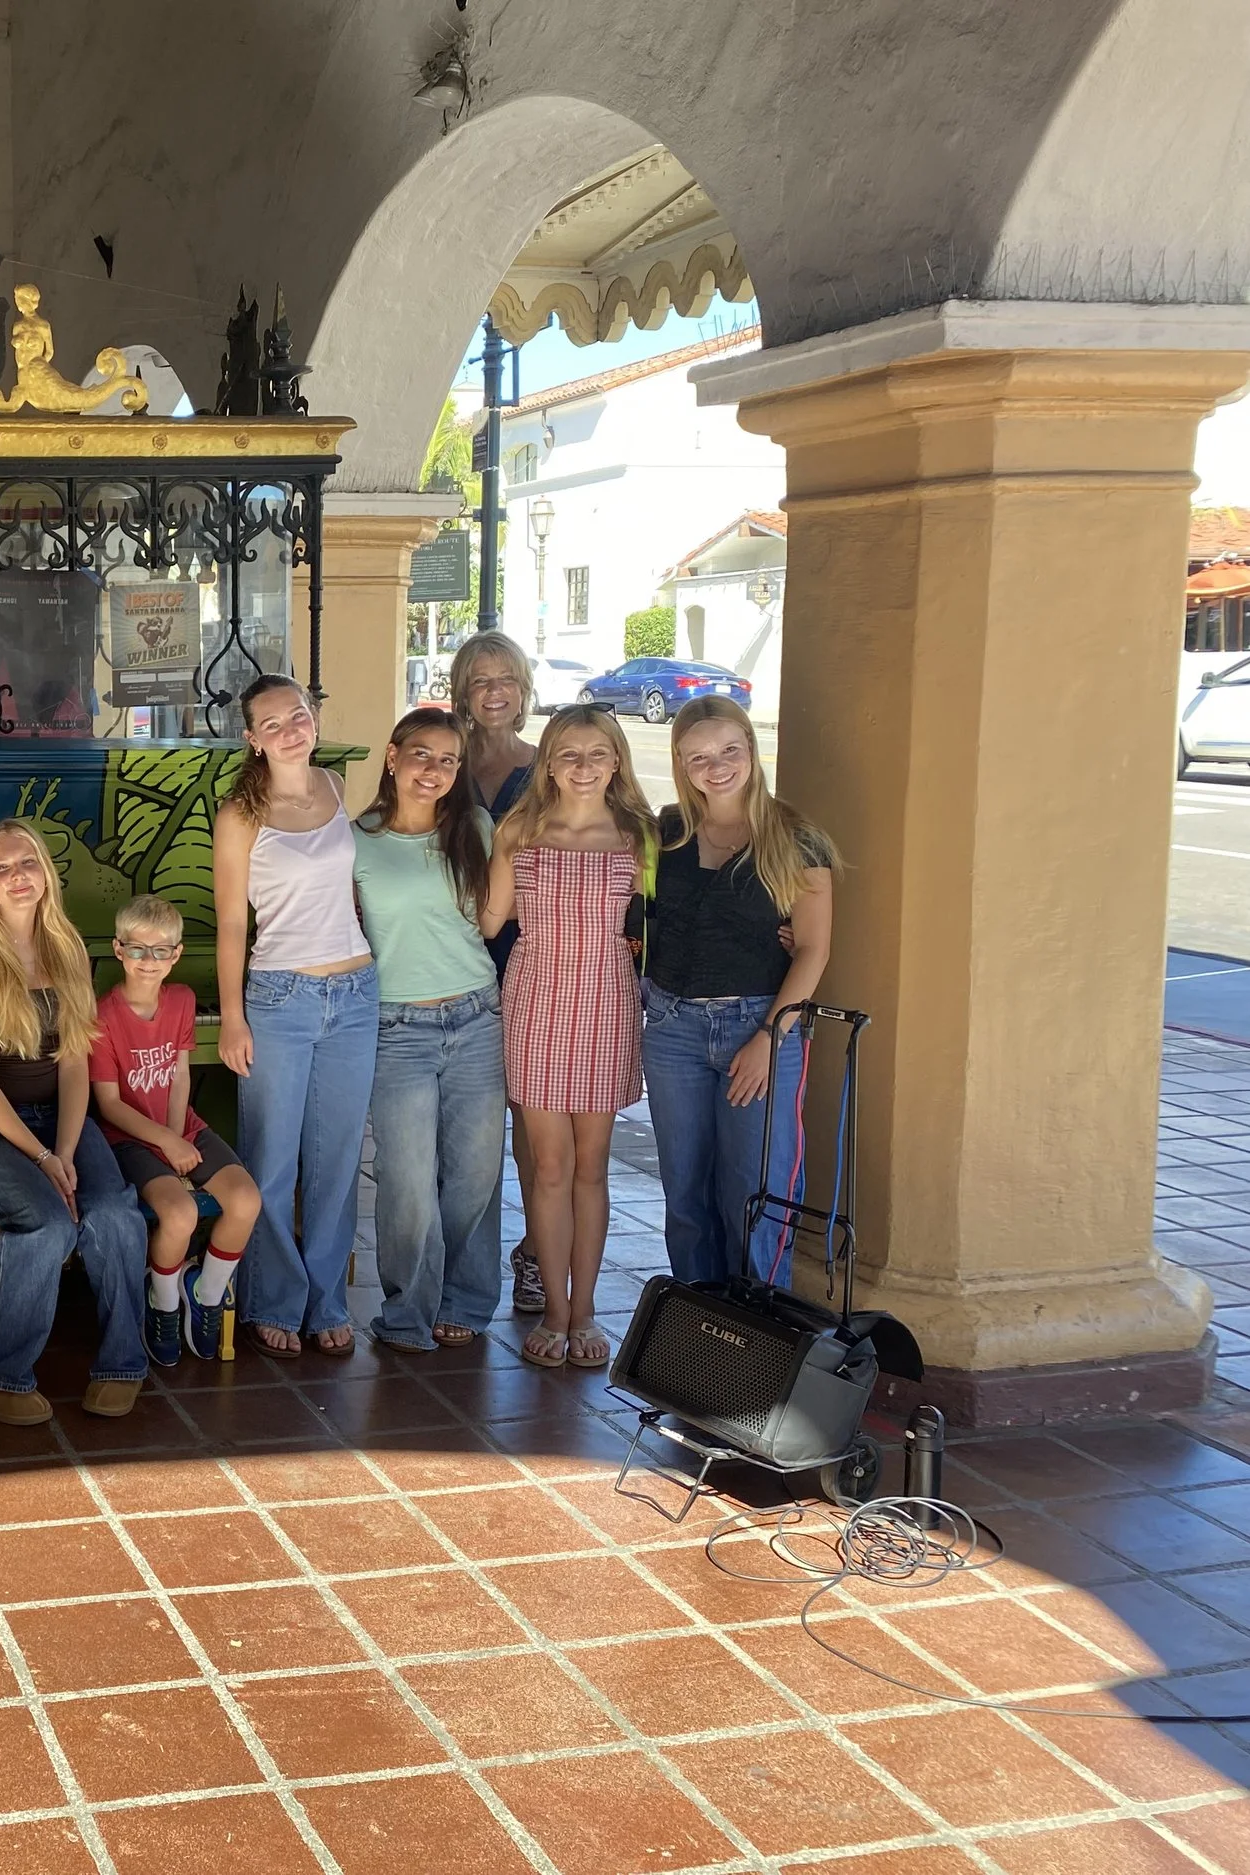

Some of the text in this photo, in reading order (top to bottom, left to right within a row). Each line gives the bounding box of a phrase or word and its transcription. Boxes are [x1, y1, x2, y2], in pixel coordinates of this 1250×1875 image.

[131, 592, 184, 608] BEST OF
[125, 607, 186, 616] SANTA BARBARA
[127, 643, 188, 664] WINNER
[700, 1322, 749, 1348] CUBE
